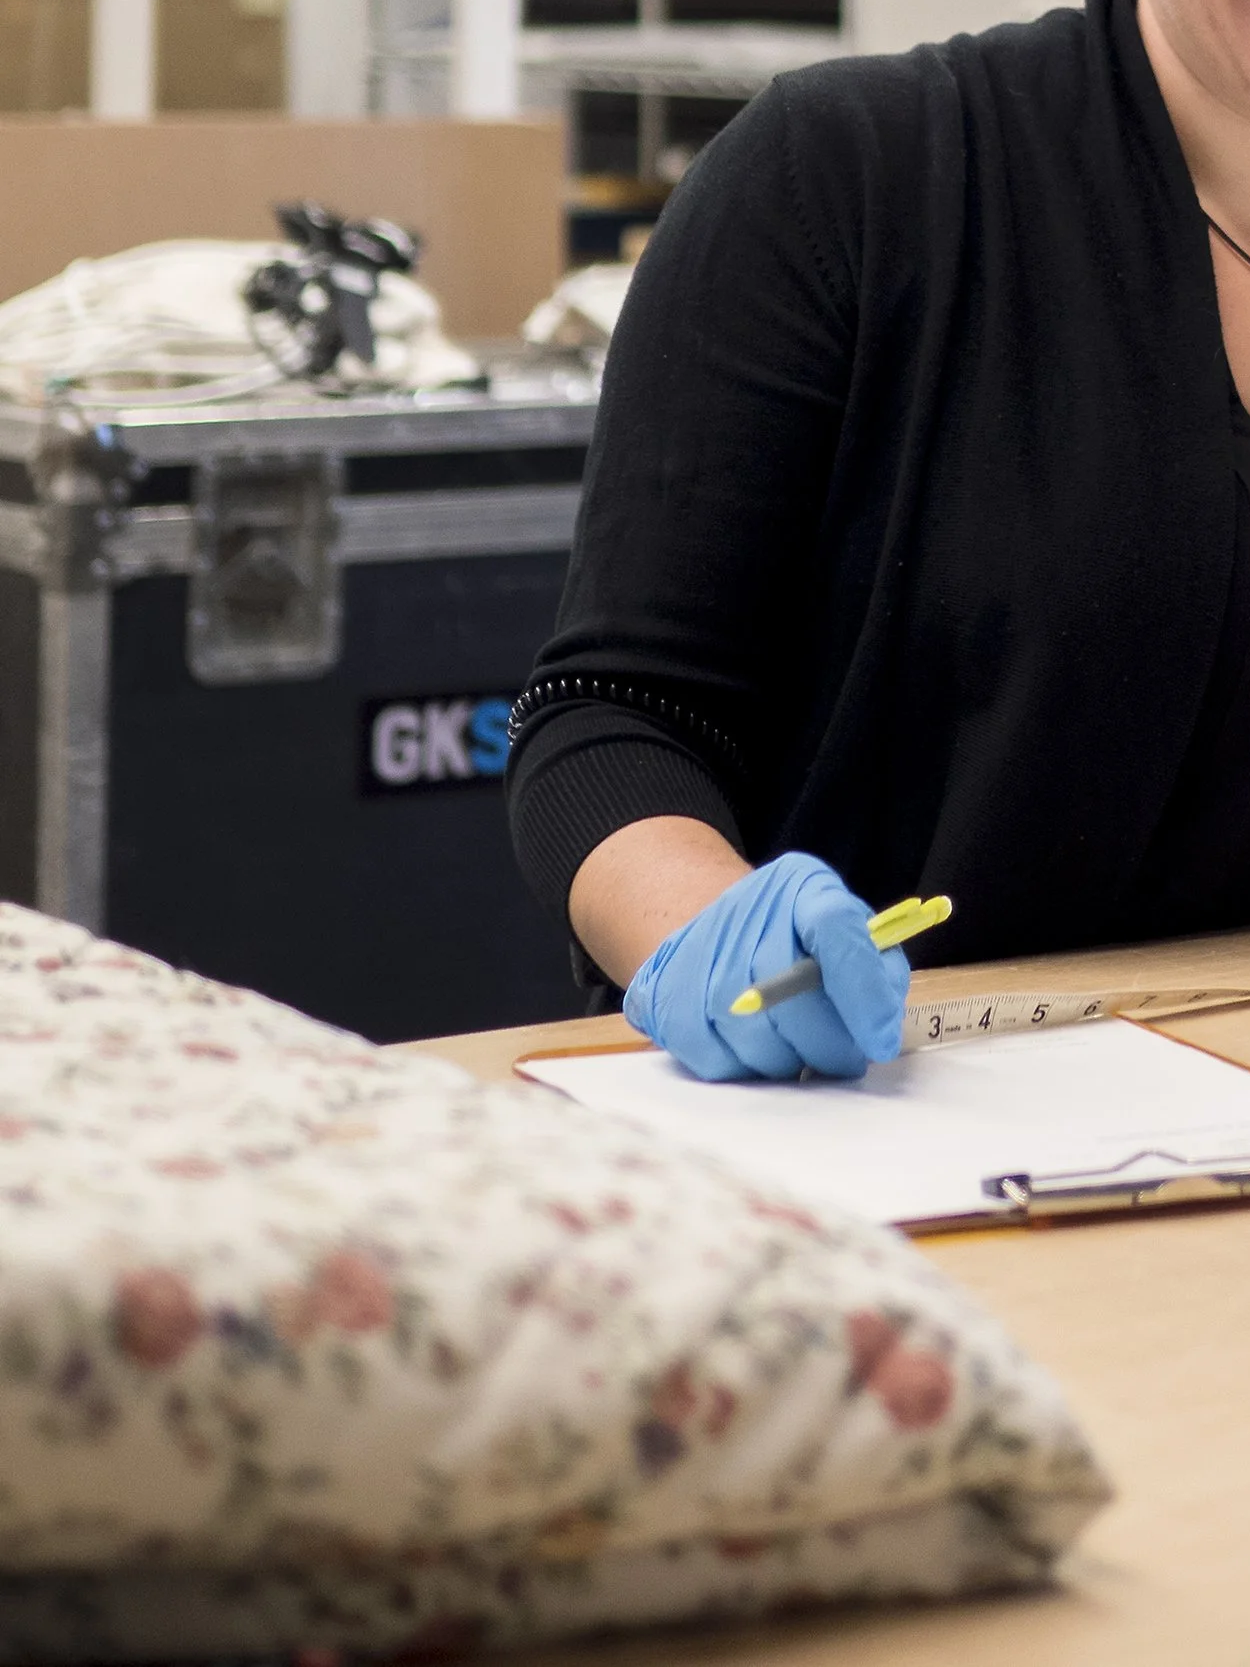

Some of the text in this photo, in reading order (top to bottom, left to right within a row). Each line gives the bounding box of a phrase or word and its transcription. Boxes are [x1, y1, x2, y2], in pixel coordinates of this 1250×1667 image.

[371, 698, 512, 785] GKS
[928, 1015, 941, 1039] 3
[978, 1006, 992, 1030] 4
[1031, 1003, 1050, 1023] 5
[1083, 1000, 1102, 1016] 6
